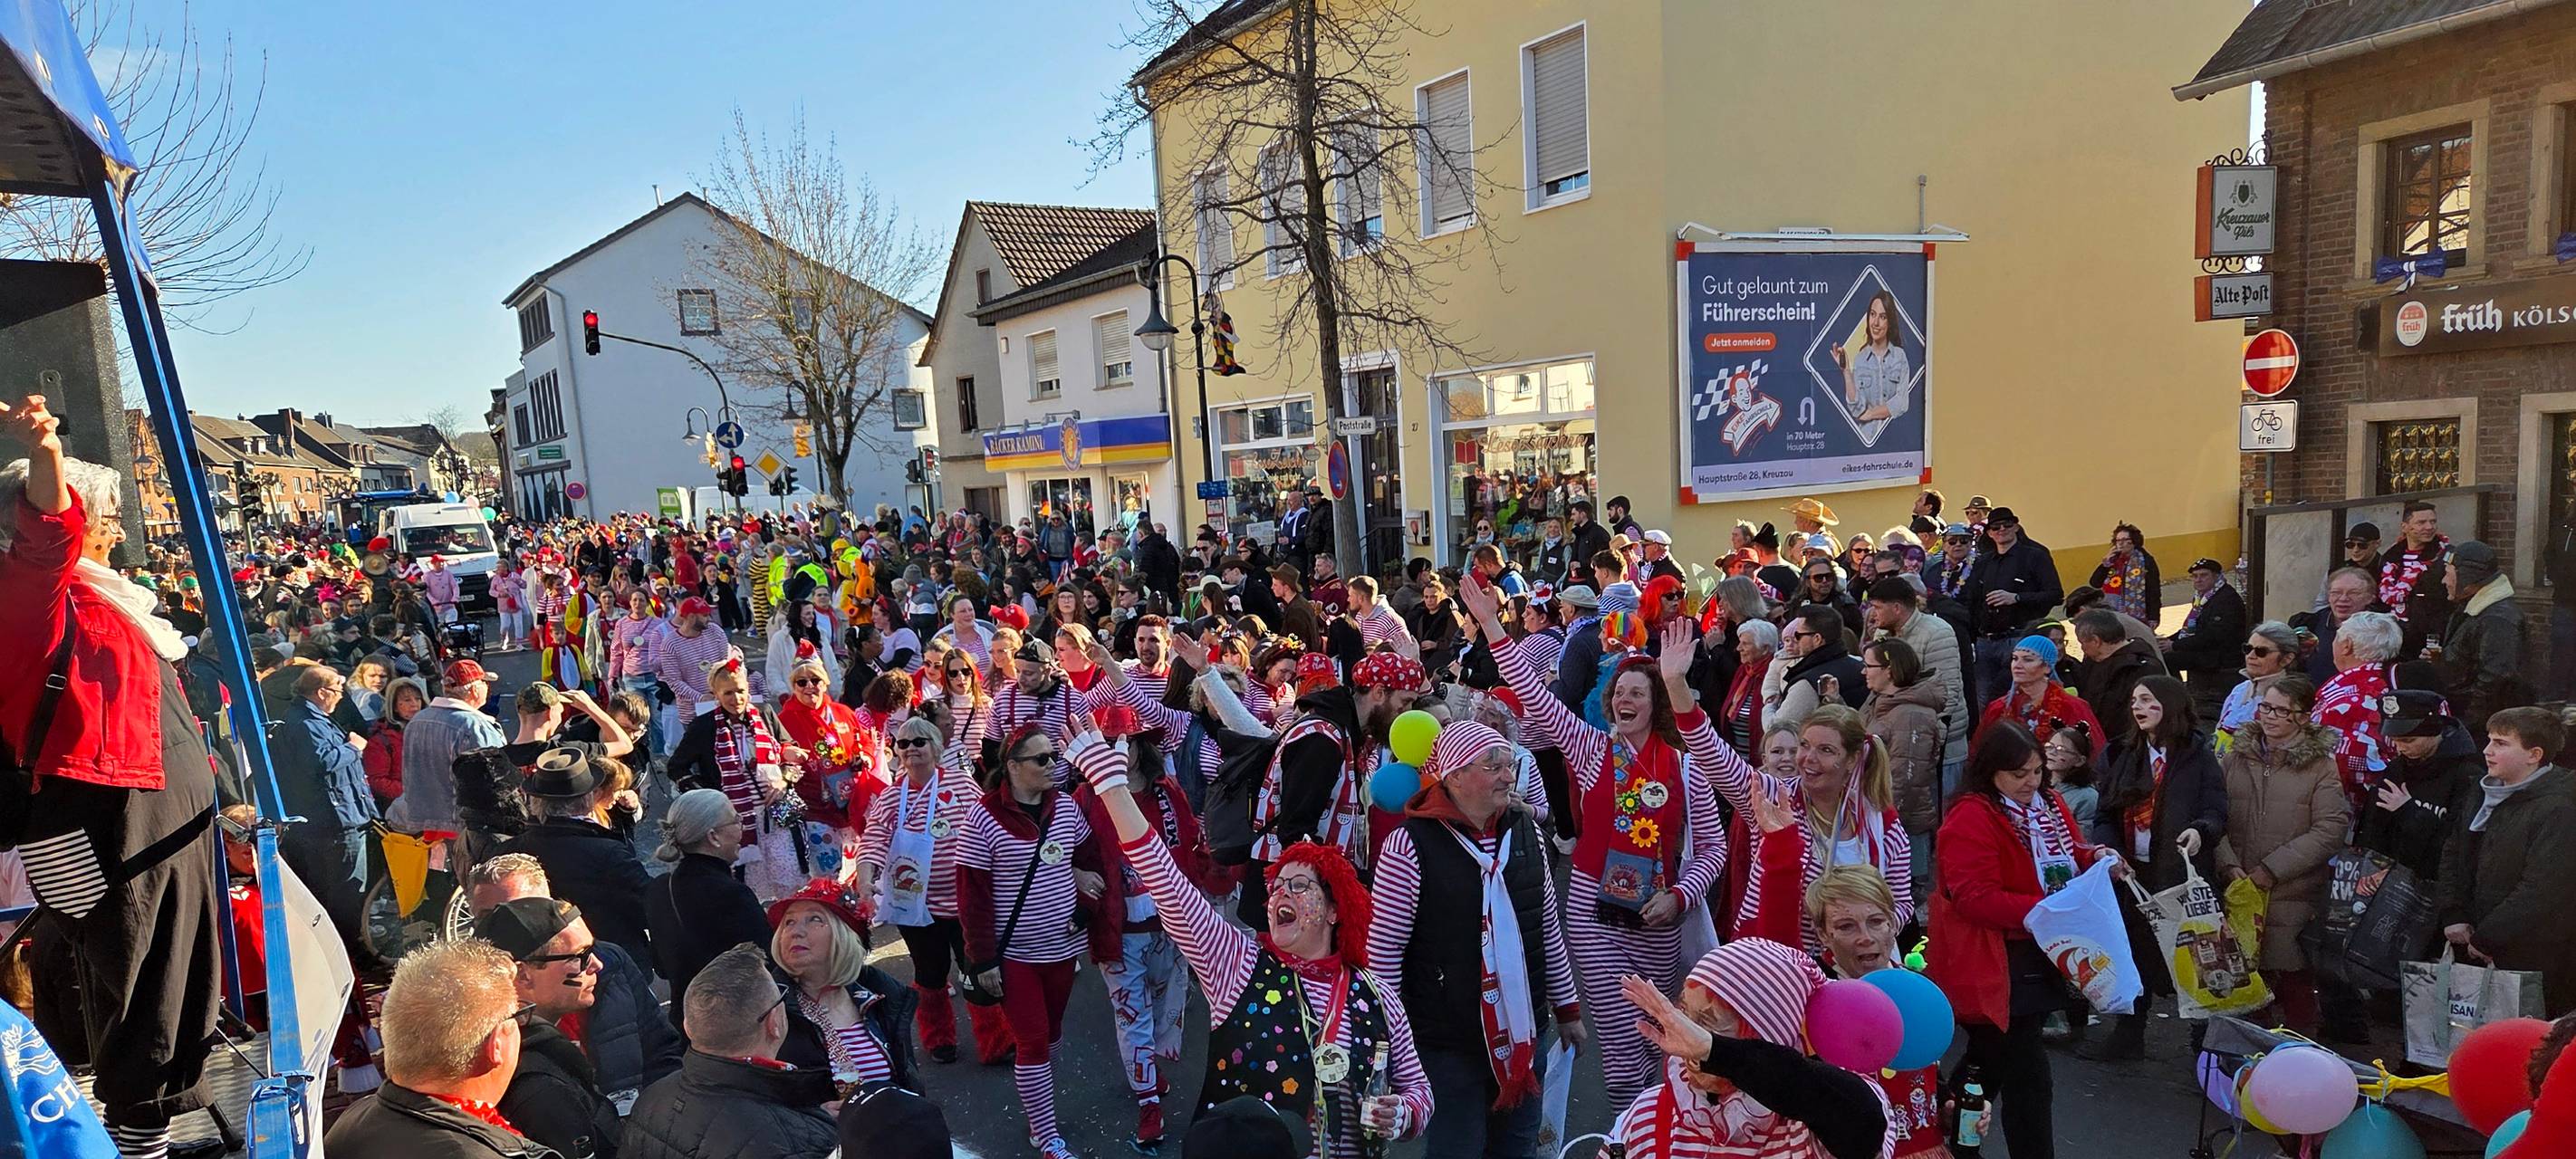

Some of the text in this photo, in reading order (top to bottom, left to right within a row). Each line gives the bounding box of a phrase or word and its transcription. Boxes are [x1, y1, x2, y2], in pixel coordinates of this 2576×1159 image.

[2216, 207, 2270, 232] Kreuzauer
[2234, 225, 2254, 241] Pils
[1702, 275, 1829, 301] Gut gelaunt zum
[2214, 286, 2240, 306] Alte
[1703, 302, 1816, 322] Führerschein!
[2440, 299, 2503, 333] früh
[1711, 338, 1771, 347] Jetzt anmelden
[1339, 419, 1371, 431] Poststraße
[1786, 431, 1825, 441] in 70 Meter
[2258, 434, 2275, 445] frei
[1816, 441, 1825, 450] 28
[1841, 459, 1914, 474] eikes-fahrschule.de
[1698, 468, 1793, 484] Hauptstraße 28, Kreuzau
[2185, 900, 2213, 917] LIEBE
